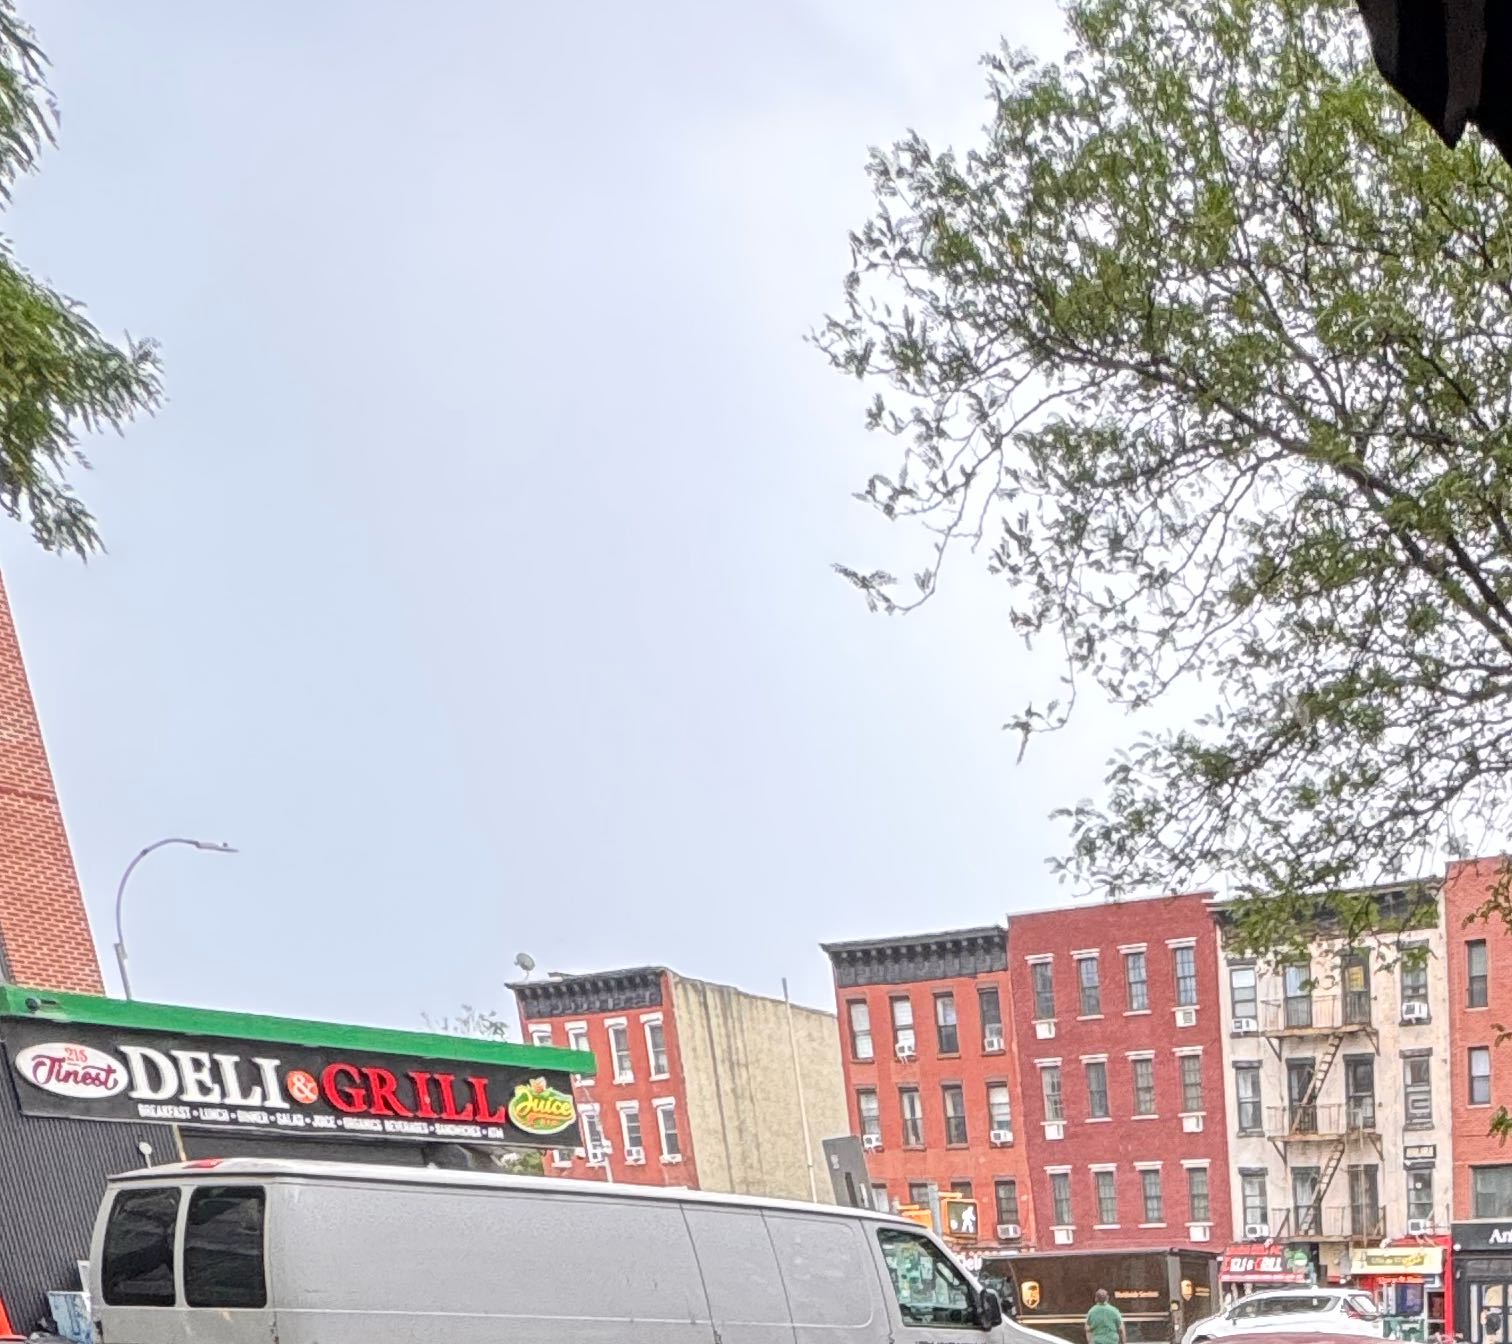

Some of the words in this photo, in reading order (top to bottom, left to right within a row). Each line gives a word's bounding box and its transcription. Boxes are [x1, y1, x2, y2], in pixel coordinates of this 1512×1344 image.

[117, 1045, 290, 1109] DELI
[292, 1074, 315, 1101] &
[321, 1062, 506, 1124] GRILL
[137, 1103, 191, 1119] BREAKFAST
[515, 1089, 571, 1116] Juice
